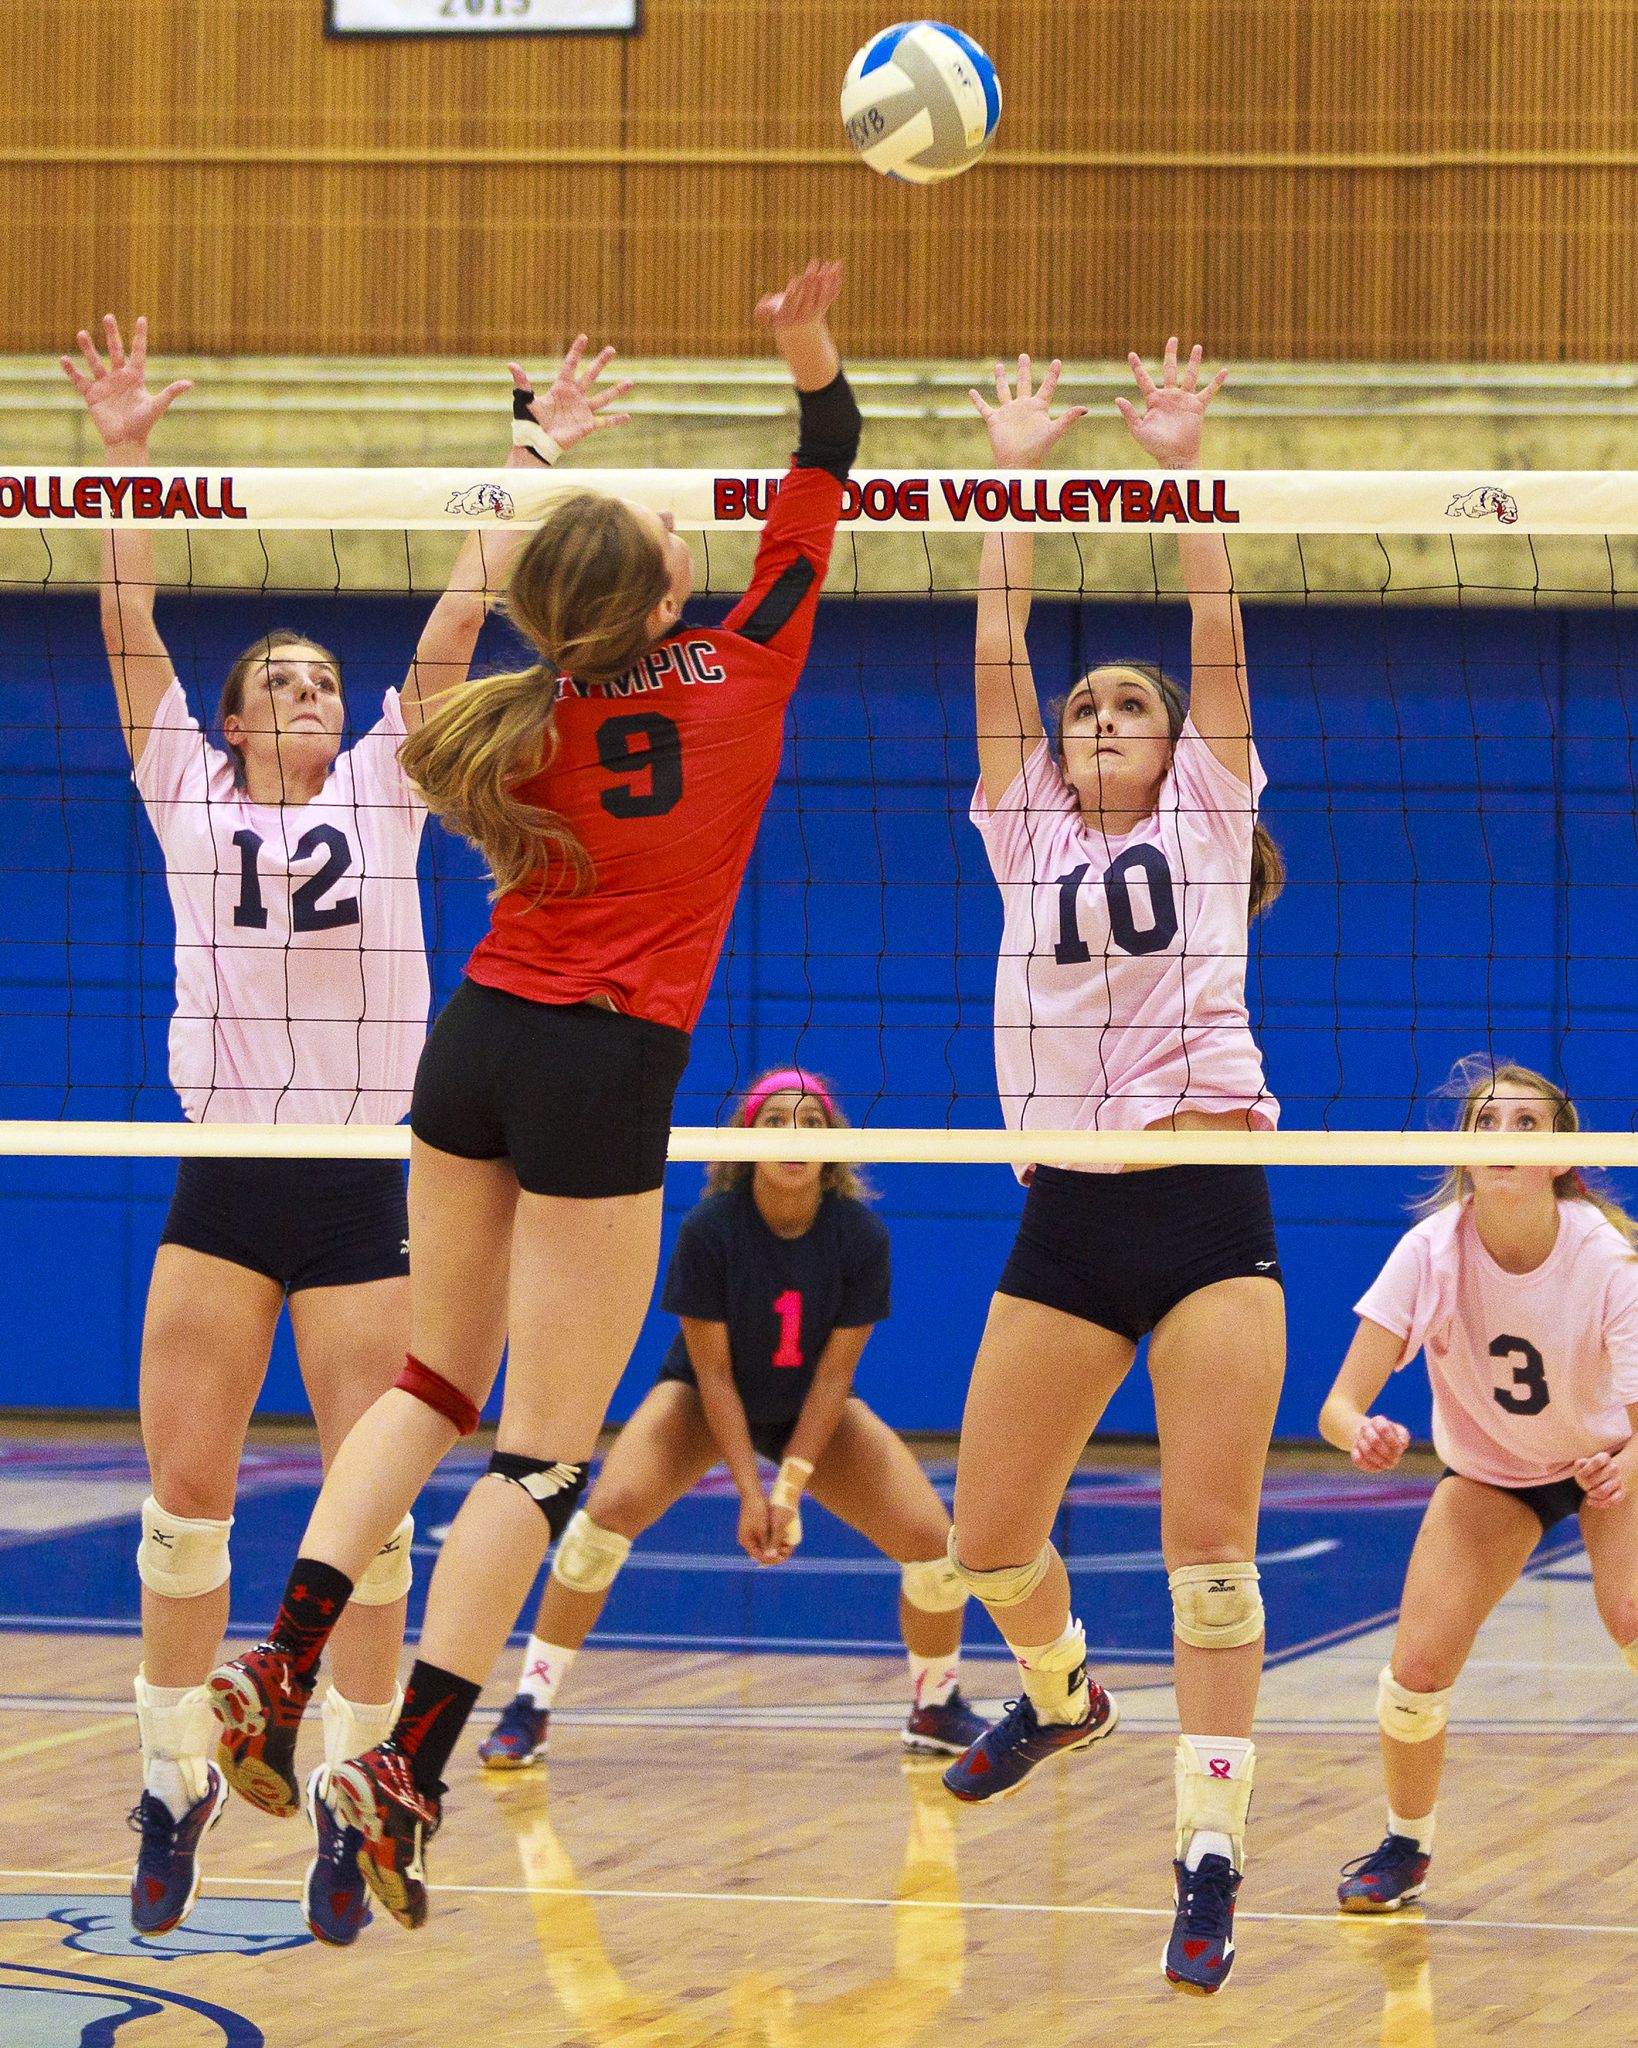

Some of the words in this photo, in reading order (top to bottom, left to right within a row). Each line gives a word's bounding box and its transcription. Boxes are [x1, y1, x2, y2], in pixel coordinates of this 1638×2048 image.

[713, 478, 930, 521] BUDOG
[939, 479, 1240, 523] VOLLEYBALL
[596, 711, 683, 819] 9
[232, 823, 360, 933] 12
[1054, 843, 1178, 965] 10
[772, 1290, 804, 1368] 1
[1489, 1333, 1550, 1416] 3
